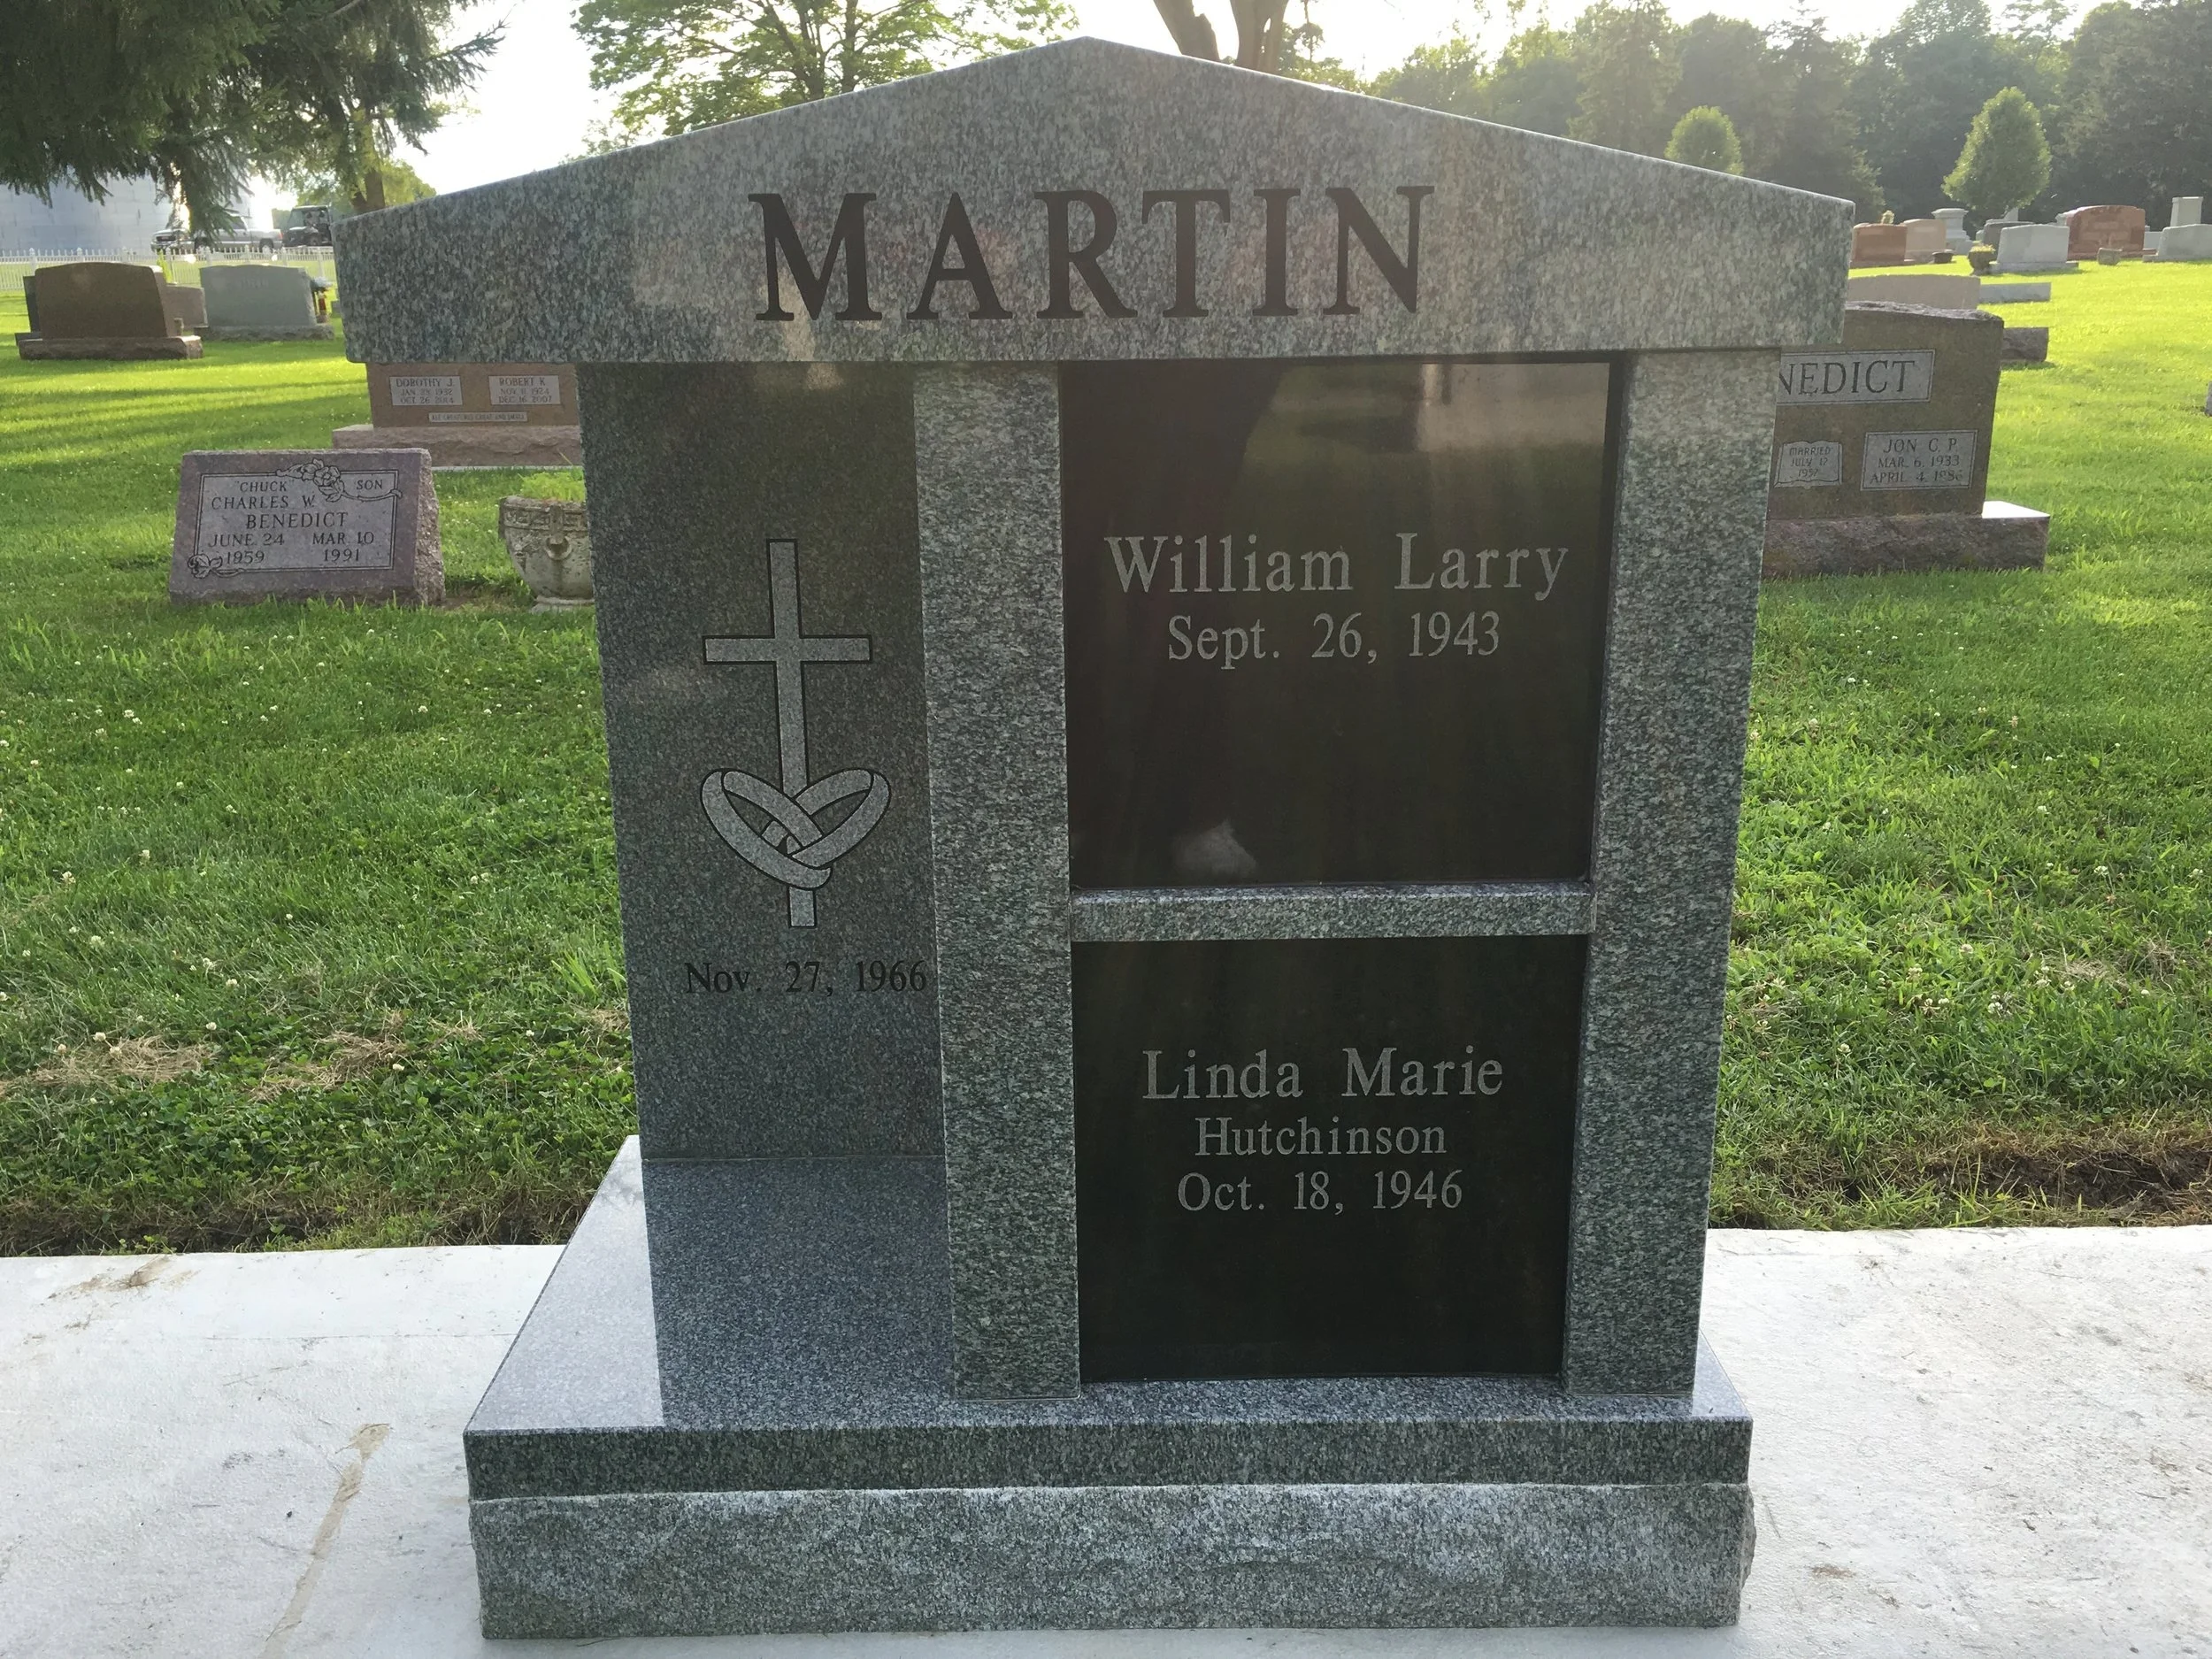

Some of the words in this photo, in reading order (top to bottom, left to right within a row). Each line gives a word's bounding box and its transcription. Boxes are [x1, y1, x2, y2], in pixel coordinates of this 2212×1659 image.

[749, 185, 1434, 321] MARTIN
[396, 378, 441, 387] DOROTHY
[499, 377, 534, 386] ROBERT
[1789, 446, 1831, 456] MARRIED
[1883, 439, 1917, 453] JON
[1790, 457, 1812, 467] JULY
[1932, 455, 1960, 467] 1933
[356, 480, 383, 490] SON
[1870, 472, 1908, 484] APRIL
[234, 480, 295, 492] "CHUCK"
[211, 495, 289, 510] CHARLES
[245, 511, 349, 529] BENEDICT
[263, 533, 285, 546] 24
[357, 531, 374, 545] 10
[227, 550, 265, 565] 1959
[323, 549, 360, 562] 1991
[1103, 534, 1354, 593] William
[1394, 532, 1569, 601] Larry
[1168, 615, 1279, 670] Sept.
[1311, 612, 1377, 664] 26,
[1408, 610, 1501, 657] 1943
[684, 961, 761, 994] Nov.
[785, 961, 833, 997] 27,
[856, 960, 927, 992] 1966
[1141, 1048, 1303, 1099] Linda
[1341, 1045, 1503, 1097] Marie
[1194, 1116, 1447, 1156] Hutchinson
[1178, 1172, 1264, 1210] Oct.
[1294, 1171, 1344, 1215] 18,
[1372, 1170, 1463, 1210] 1946
